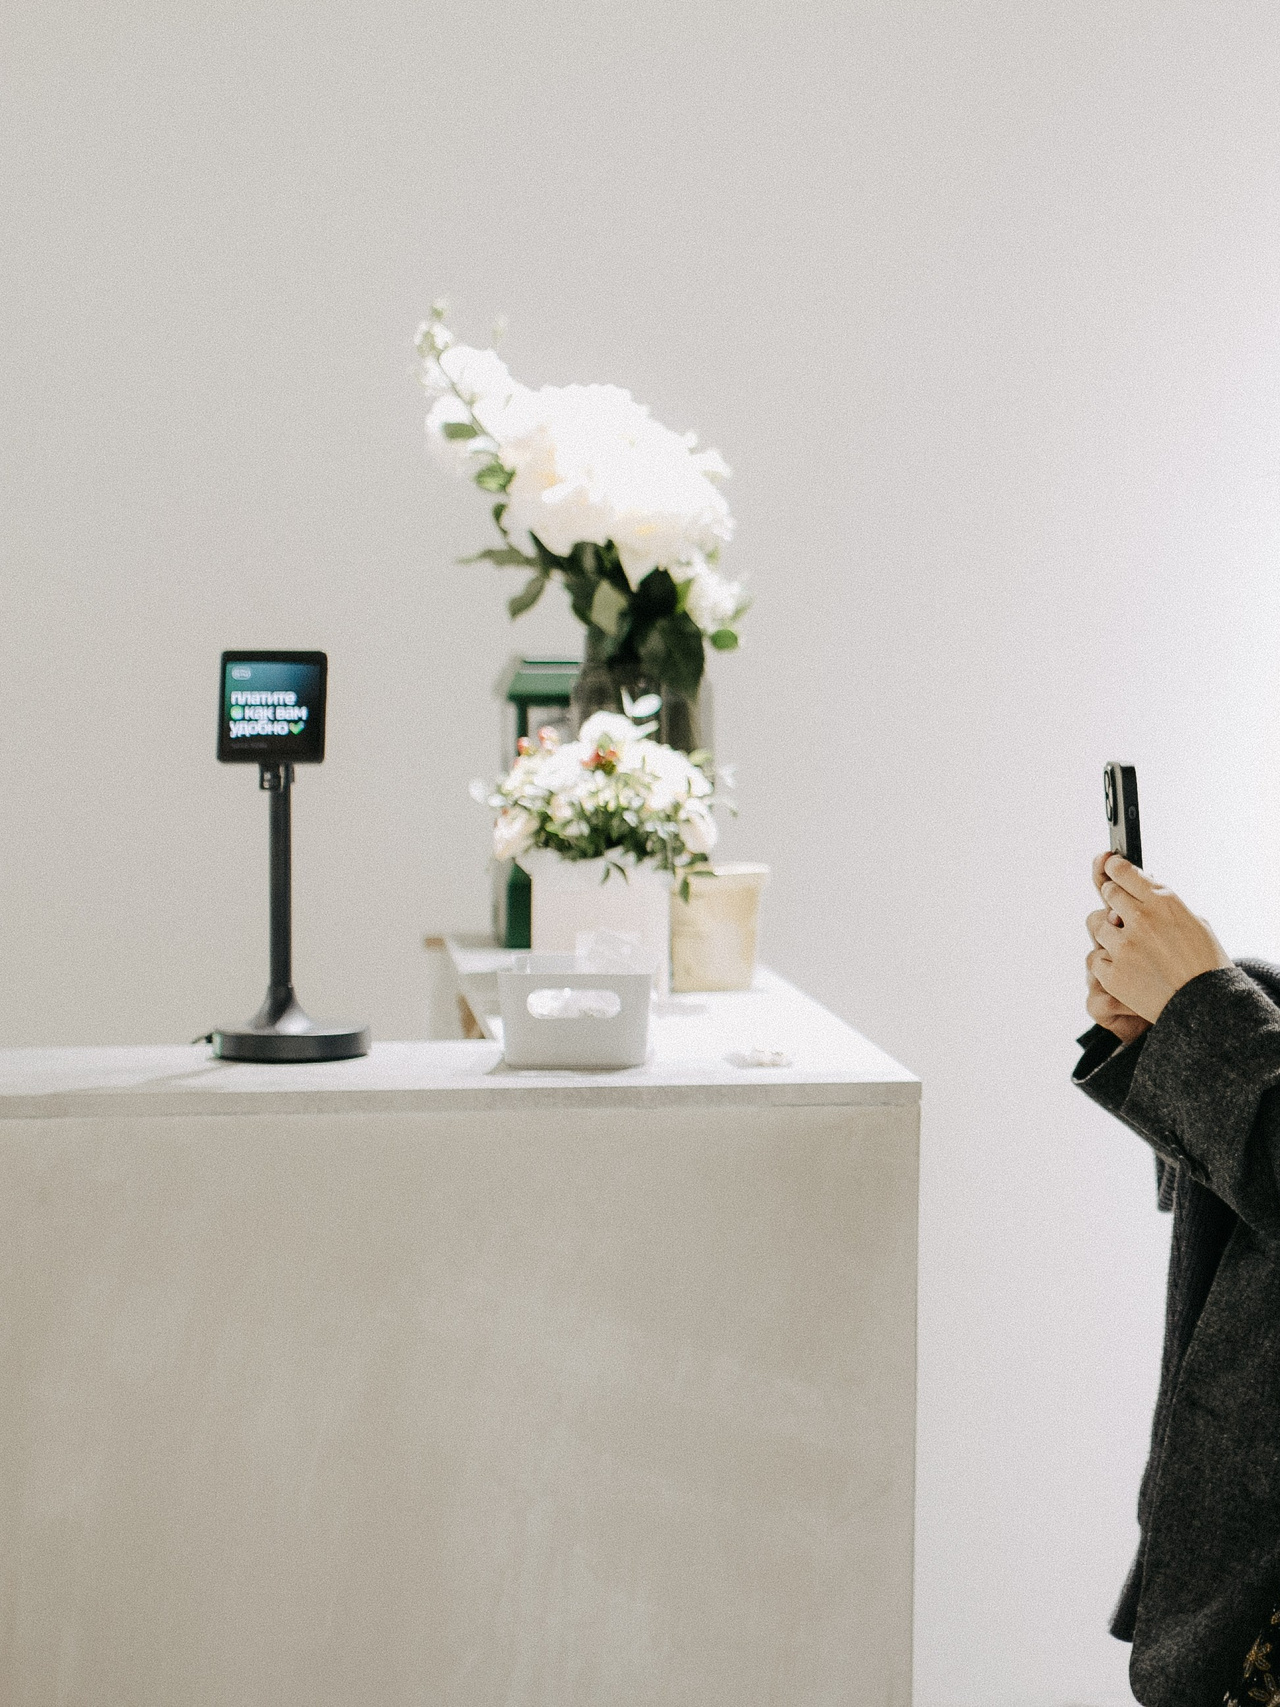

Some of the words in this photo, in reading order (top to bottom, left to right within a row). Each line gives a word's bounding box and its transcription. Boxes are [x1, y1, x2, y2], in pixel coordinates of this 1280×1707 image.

[230, 691, 297, 706] платите
[244, 706, 274, 720] как
[275, 706, 308, 720] вам
[229, 719, 289, 738] удобно
